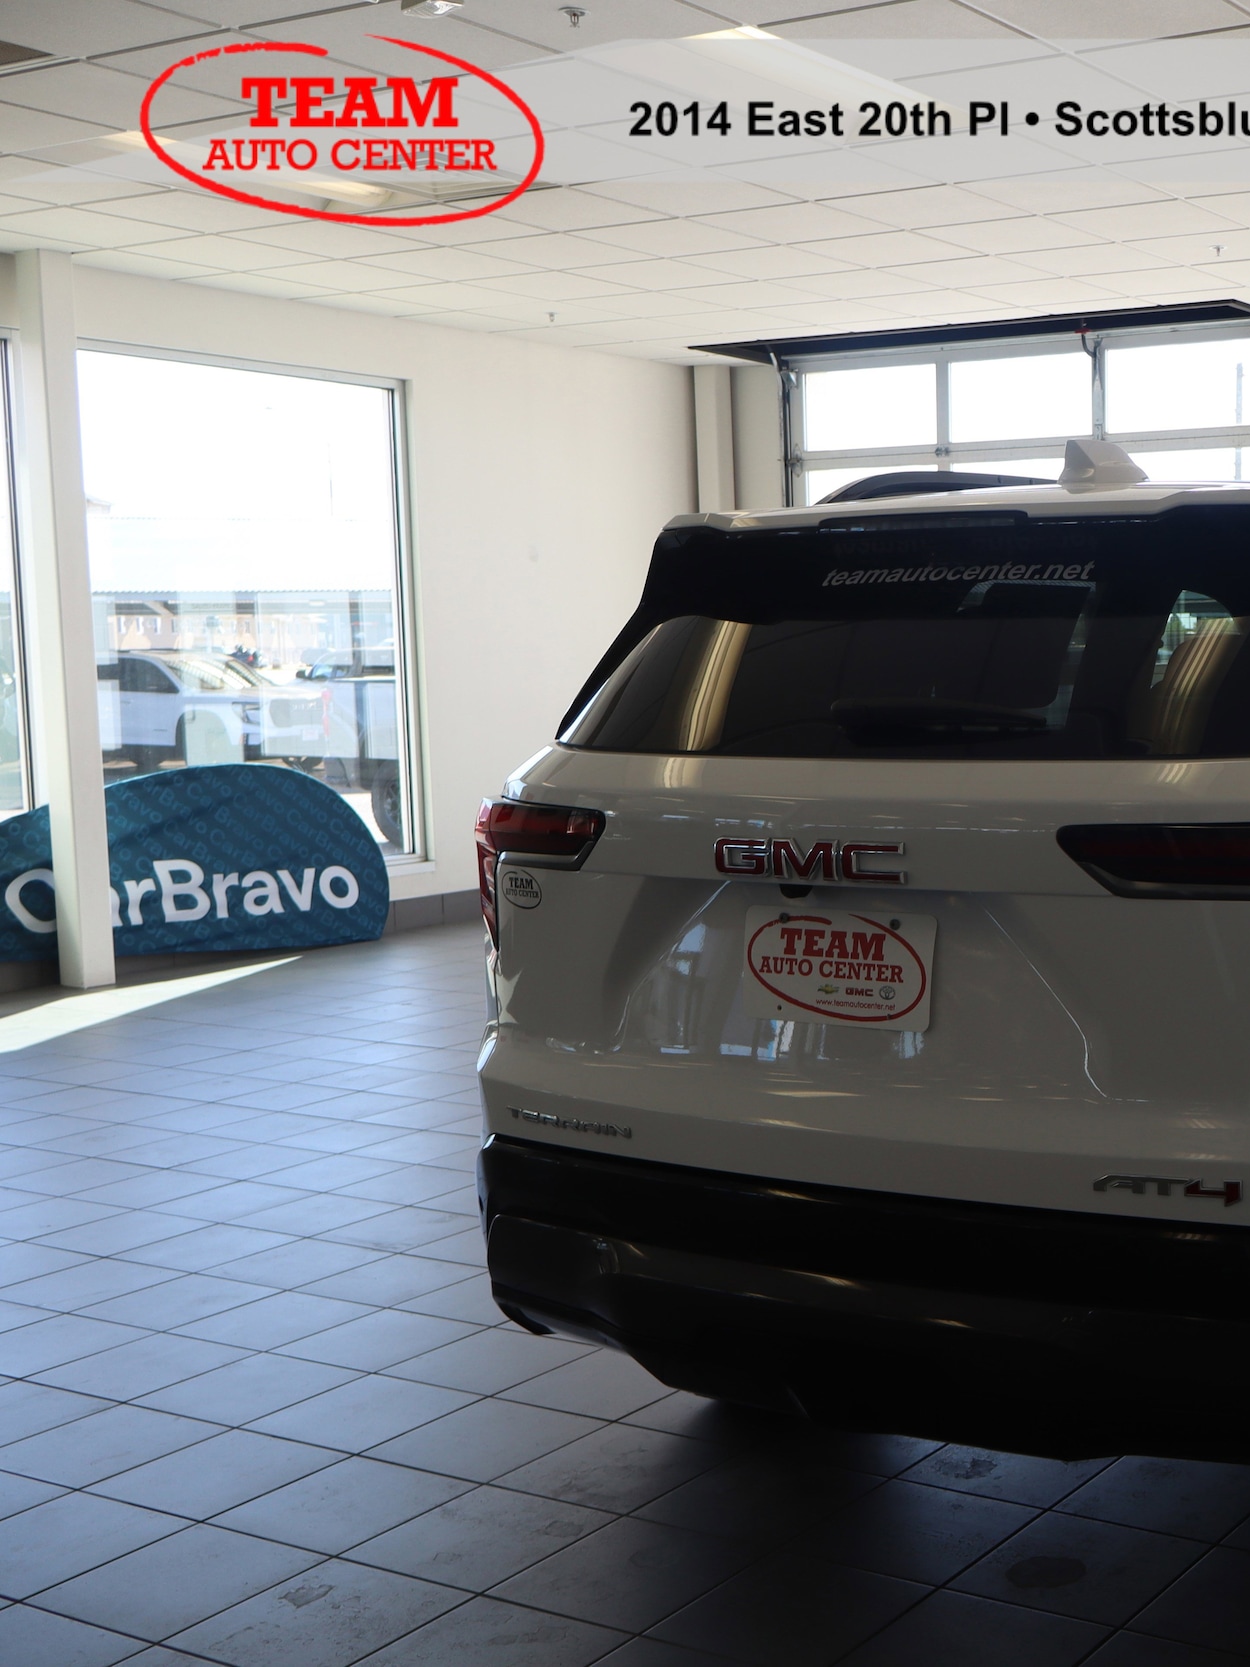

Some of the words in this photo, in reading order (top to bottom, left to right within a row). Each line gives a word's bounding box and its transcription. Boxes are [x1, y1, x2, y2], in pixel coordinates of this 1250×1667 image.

[821, 560, 1096, 587] teamautocenter.net
[713, 837, 908, 884] GMC
[505, 888, 519, 897] AUTO
[518, 889, 540, 899] CENTER
[509, 877, 534, 890] TEAM
[781, 927, 886, 961] TEAM
[759, 956, 813, 977] AUTO
[819, 959, 904, 984] CENTER
[815, 998, 896, 1011] www.teamautocenter.net
[845, 987, 874, 997] GMC
[506, 1104, 632, 1140] TERRAIN
[1092, 1173, 1244, 1208] AT4
